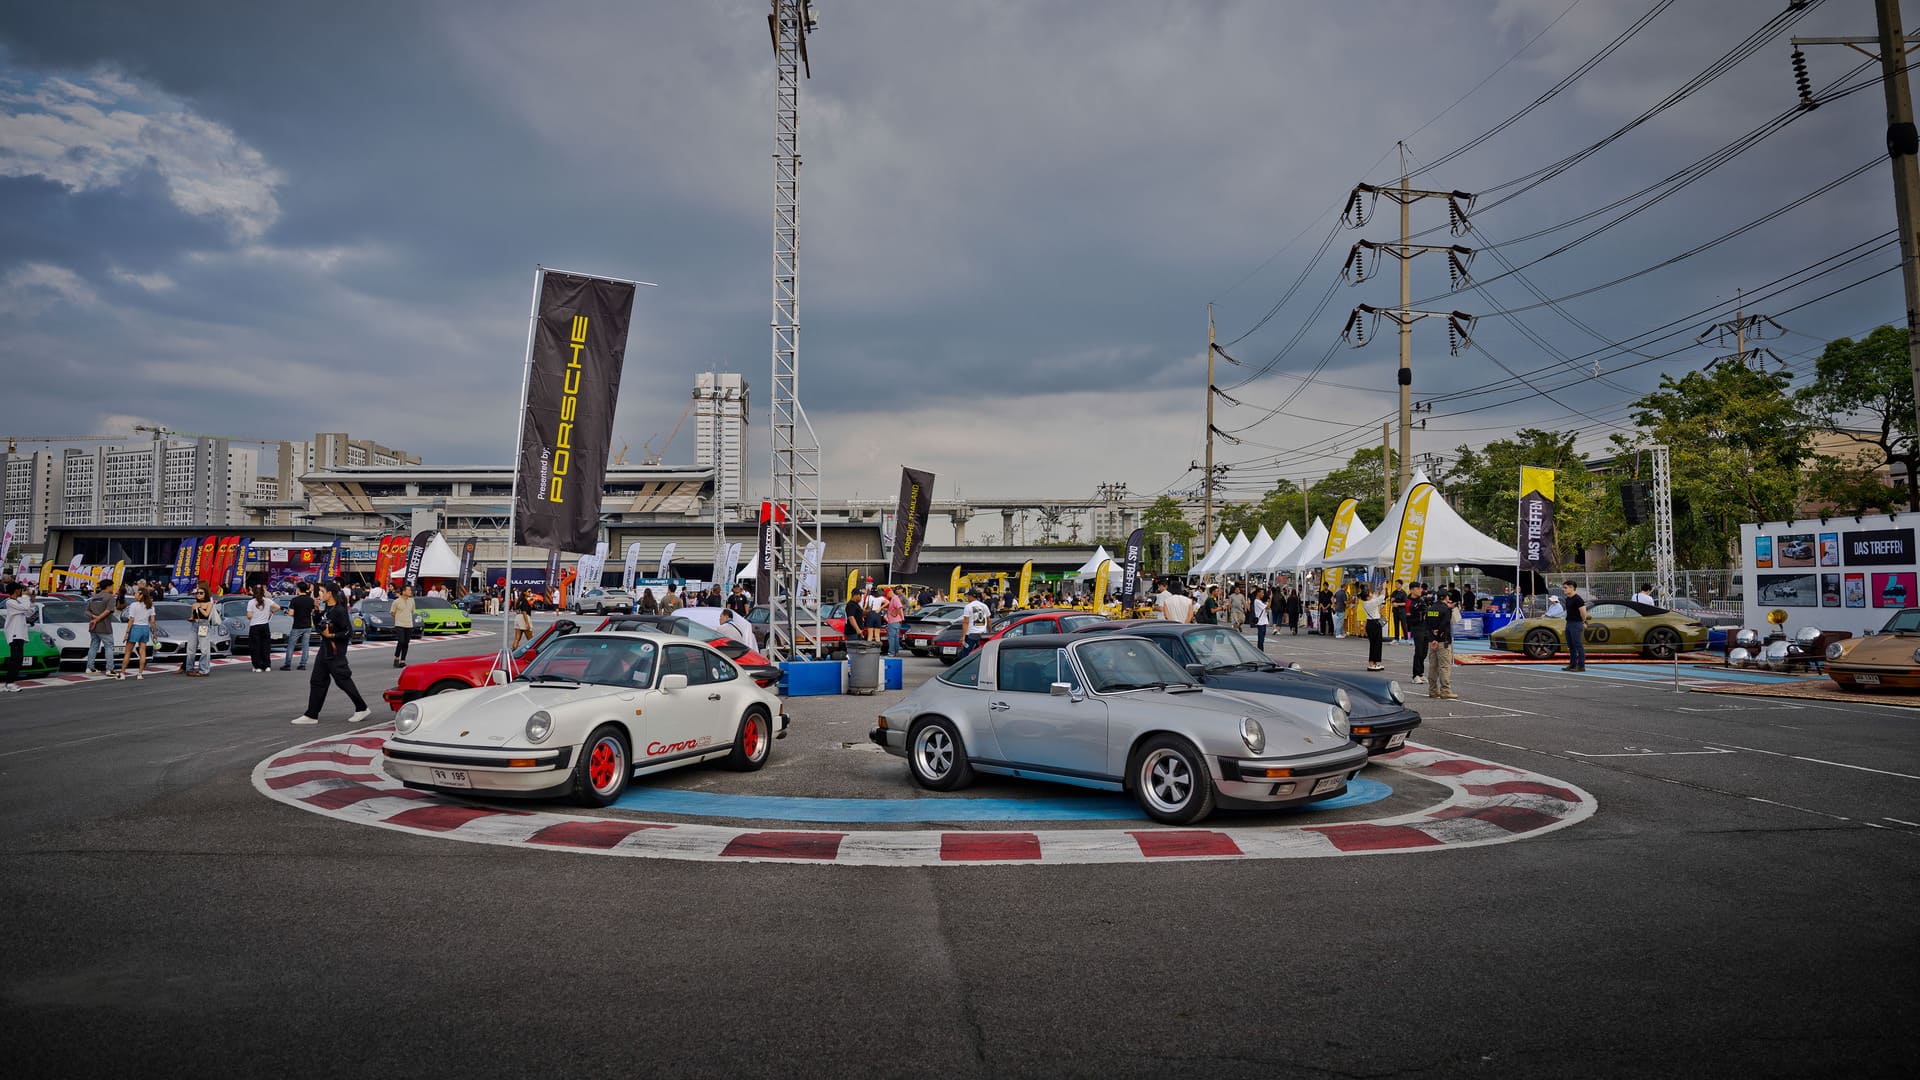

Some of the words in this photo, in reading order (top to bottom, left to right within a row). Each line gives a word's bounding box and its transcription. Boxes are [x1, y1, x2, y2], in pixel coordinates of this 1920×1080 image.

[550, 315, 588, 503] PORSCHE
[540, 447, 551, 459] by:
[537, 460, 548, 500] Presented
[908, 484, 920, 520] THAILAND
[1528, 500, 1543, 541] TREFFEN
[903, 522, 914, 556] PORSCHE
[1527, 541, 1540, 561] DAS
[1853, 541, 1869, 556] DAS
[1869, 539, 1904, 555] TREFFEN
[1127, 545, 1138, 561] DAS
[1401, 528, 1420, 592] SINGHA
[1124, 562, 1136, 595] TREFFEN
[1586, 627, 1608, 641] 70
[646, 739, 697, 756] Carrera
[451, 772, 466, 781] 195
